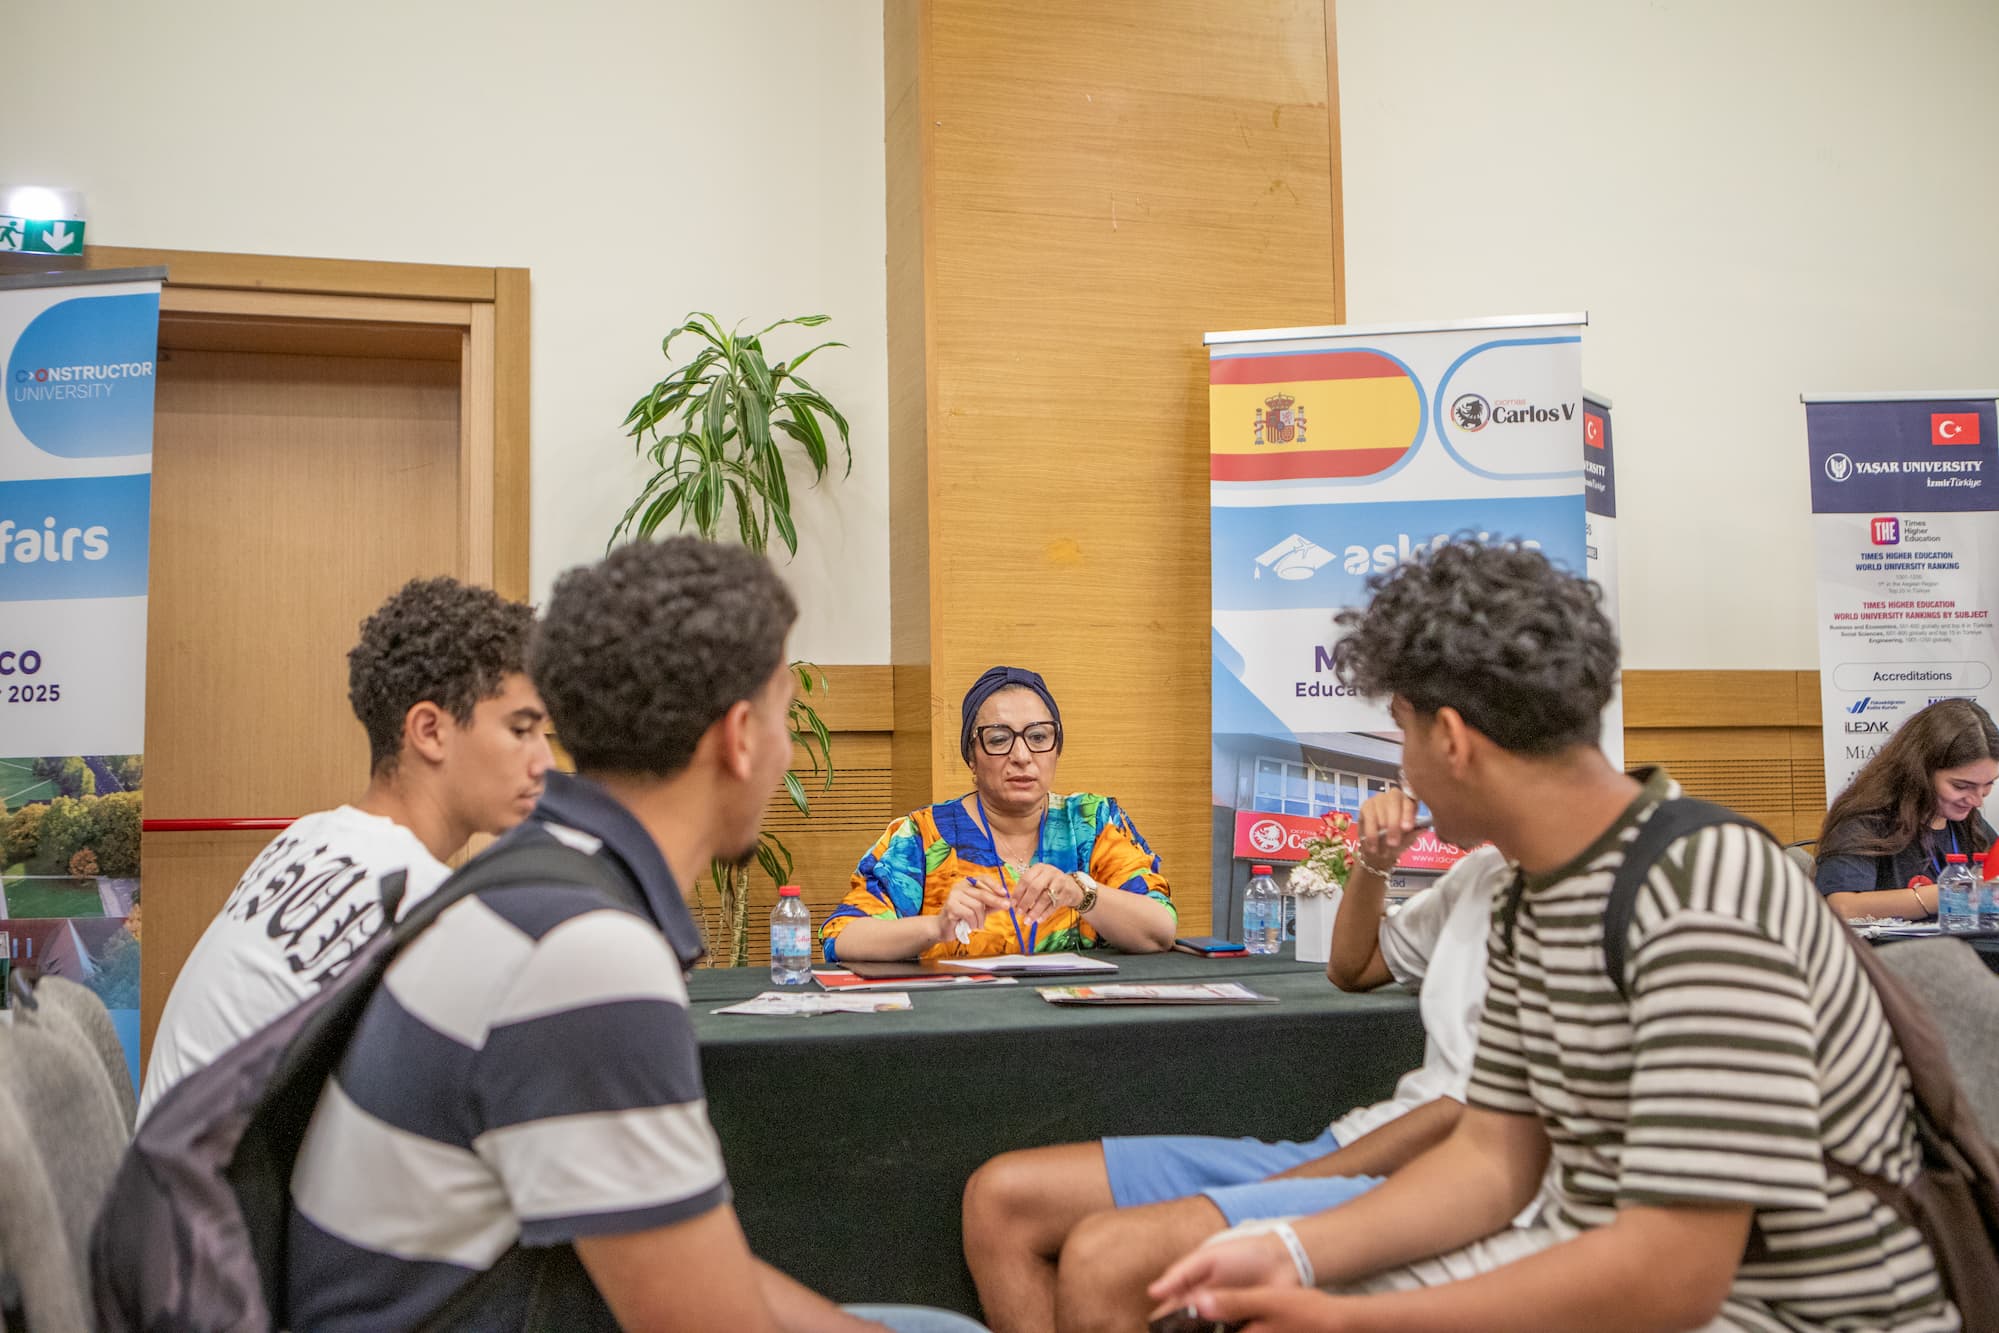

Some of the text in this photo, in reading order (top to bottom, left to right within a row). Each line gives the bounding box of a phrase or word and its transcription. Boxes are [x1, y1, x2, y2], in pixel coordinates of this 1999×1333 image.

[15, 383, 114, 402] UNIVERSITY
[1492, 402, 1576, 424] Carlos V
[1902, 460, 1983, 473] UNIVERSITY
[1874, 521, 1897, 542] THE
[1861, 552, 1884, 560] TIMES
[1886, 552, 1912, 560] HIGHER
[1856, 562, 1960, 571] WORLD UNIVERSITY RANKING
[1888, 601, 1915, 609] HIGHER
[1834, 610, 1988, 620] WORLD UNIVERSITY RANKINGS BY SUBJECT
[1873, 670, 1953, 682] Accreditations
[8, 684, 60, 702] 2025
